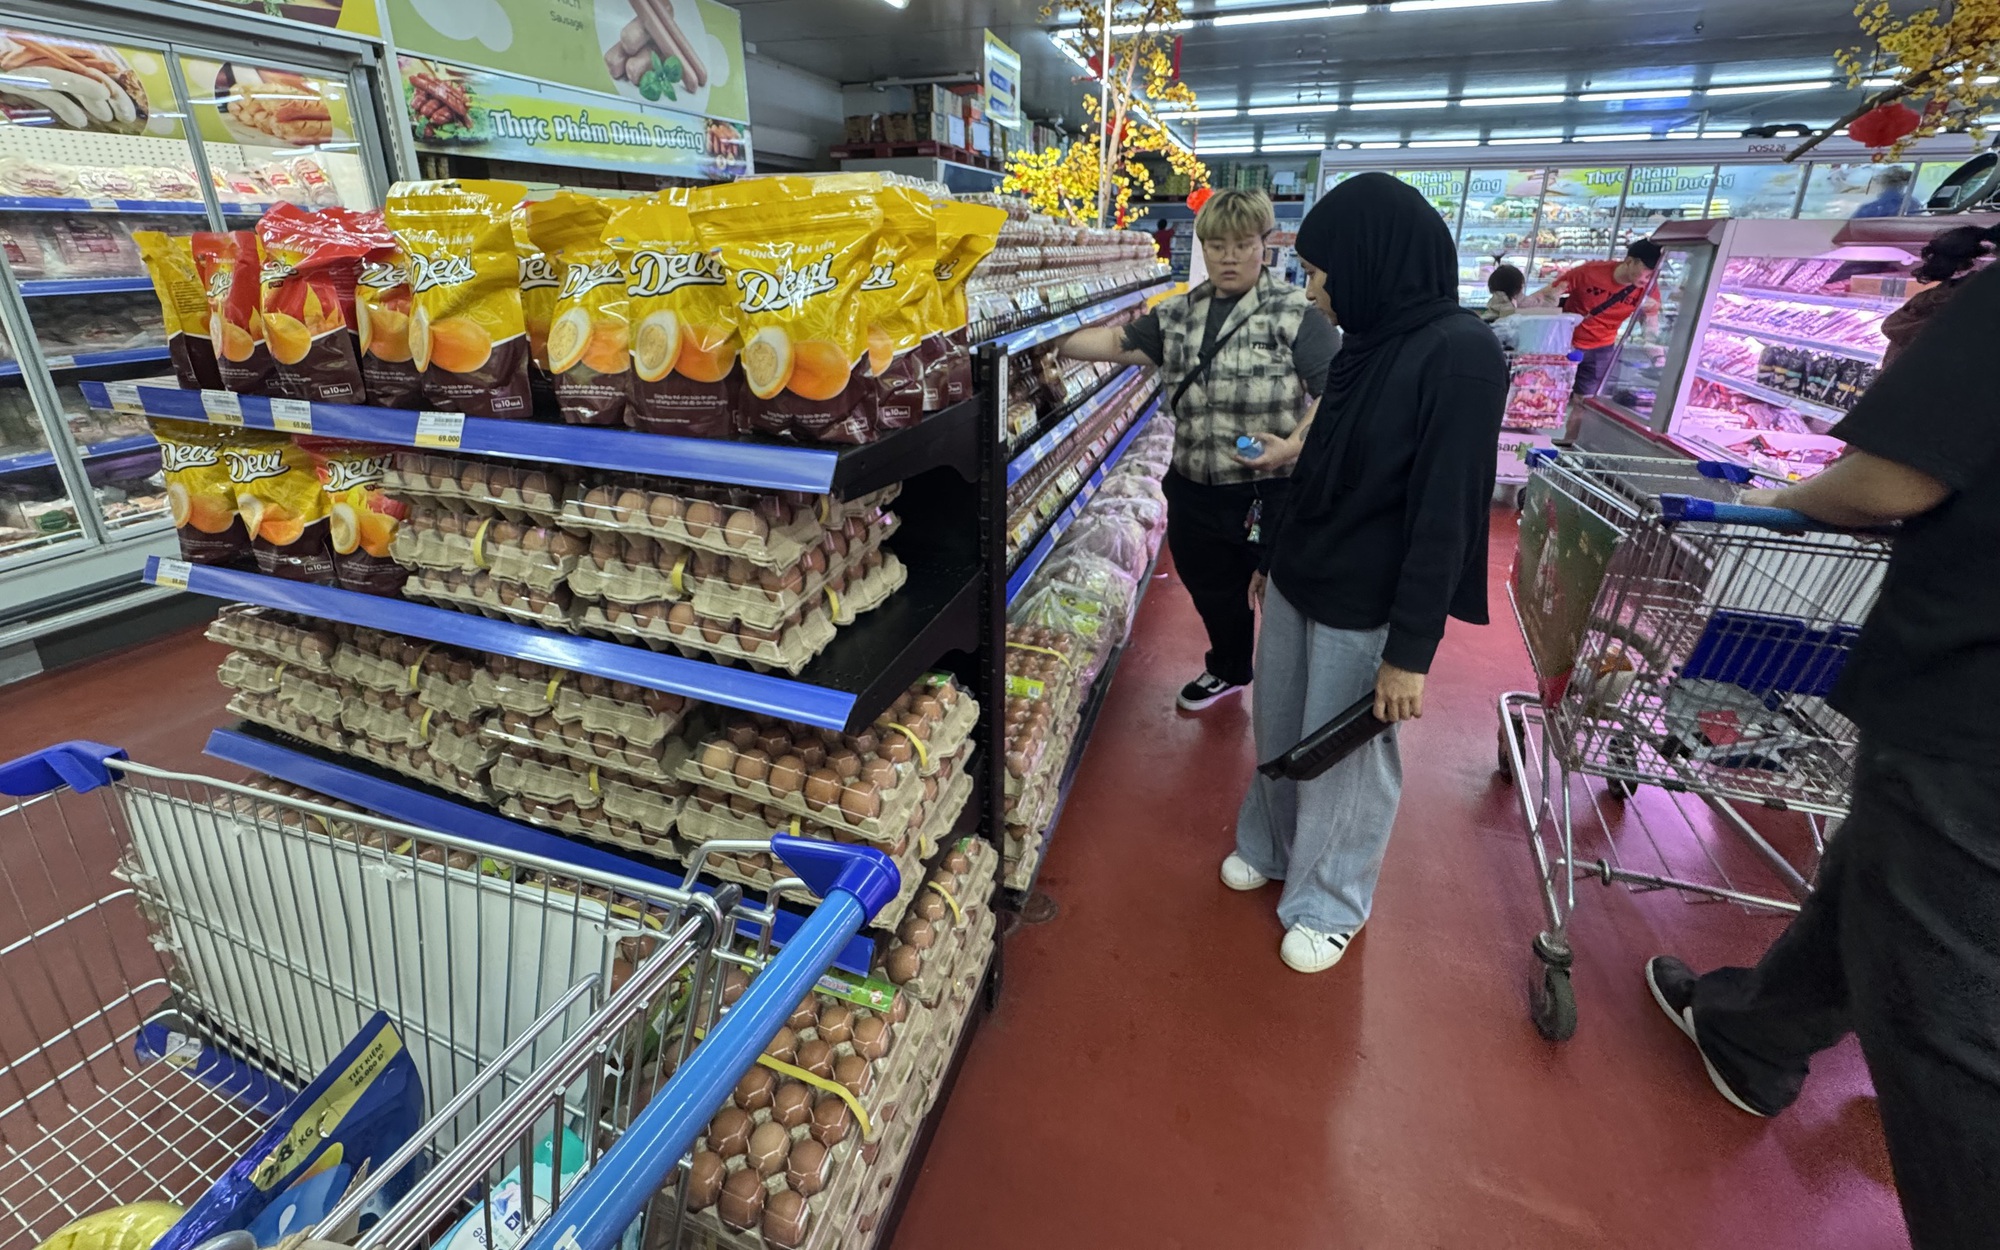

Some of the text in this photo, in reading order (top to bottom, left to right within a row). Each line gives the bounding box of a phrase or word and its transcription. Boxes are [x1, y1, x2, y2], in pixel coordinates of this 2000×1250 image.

[490, 109, 549, 145] Thực
[552, 108, 609, 143] Phẩm
[653, 126, 705, 154] Dưỡng
[736, 252, 840, 314] Devi
[438, 435, 460, 443] 69.000
[161, 442, 225, 472] Devi
[223, 449, 291, 484] Devi
[297, 1125, 315, 1147] KG
